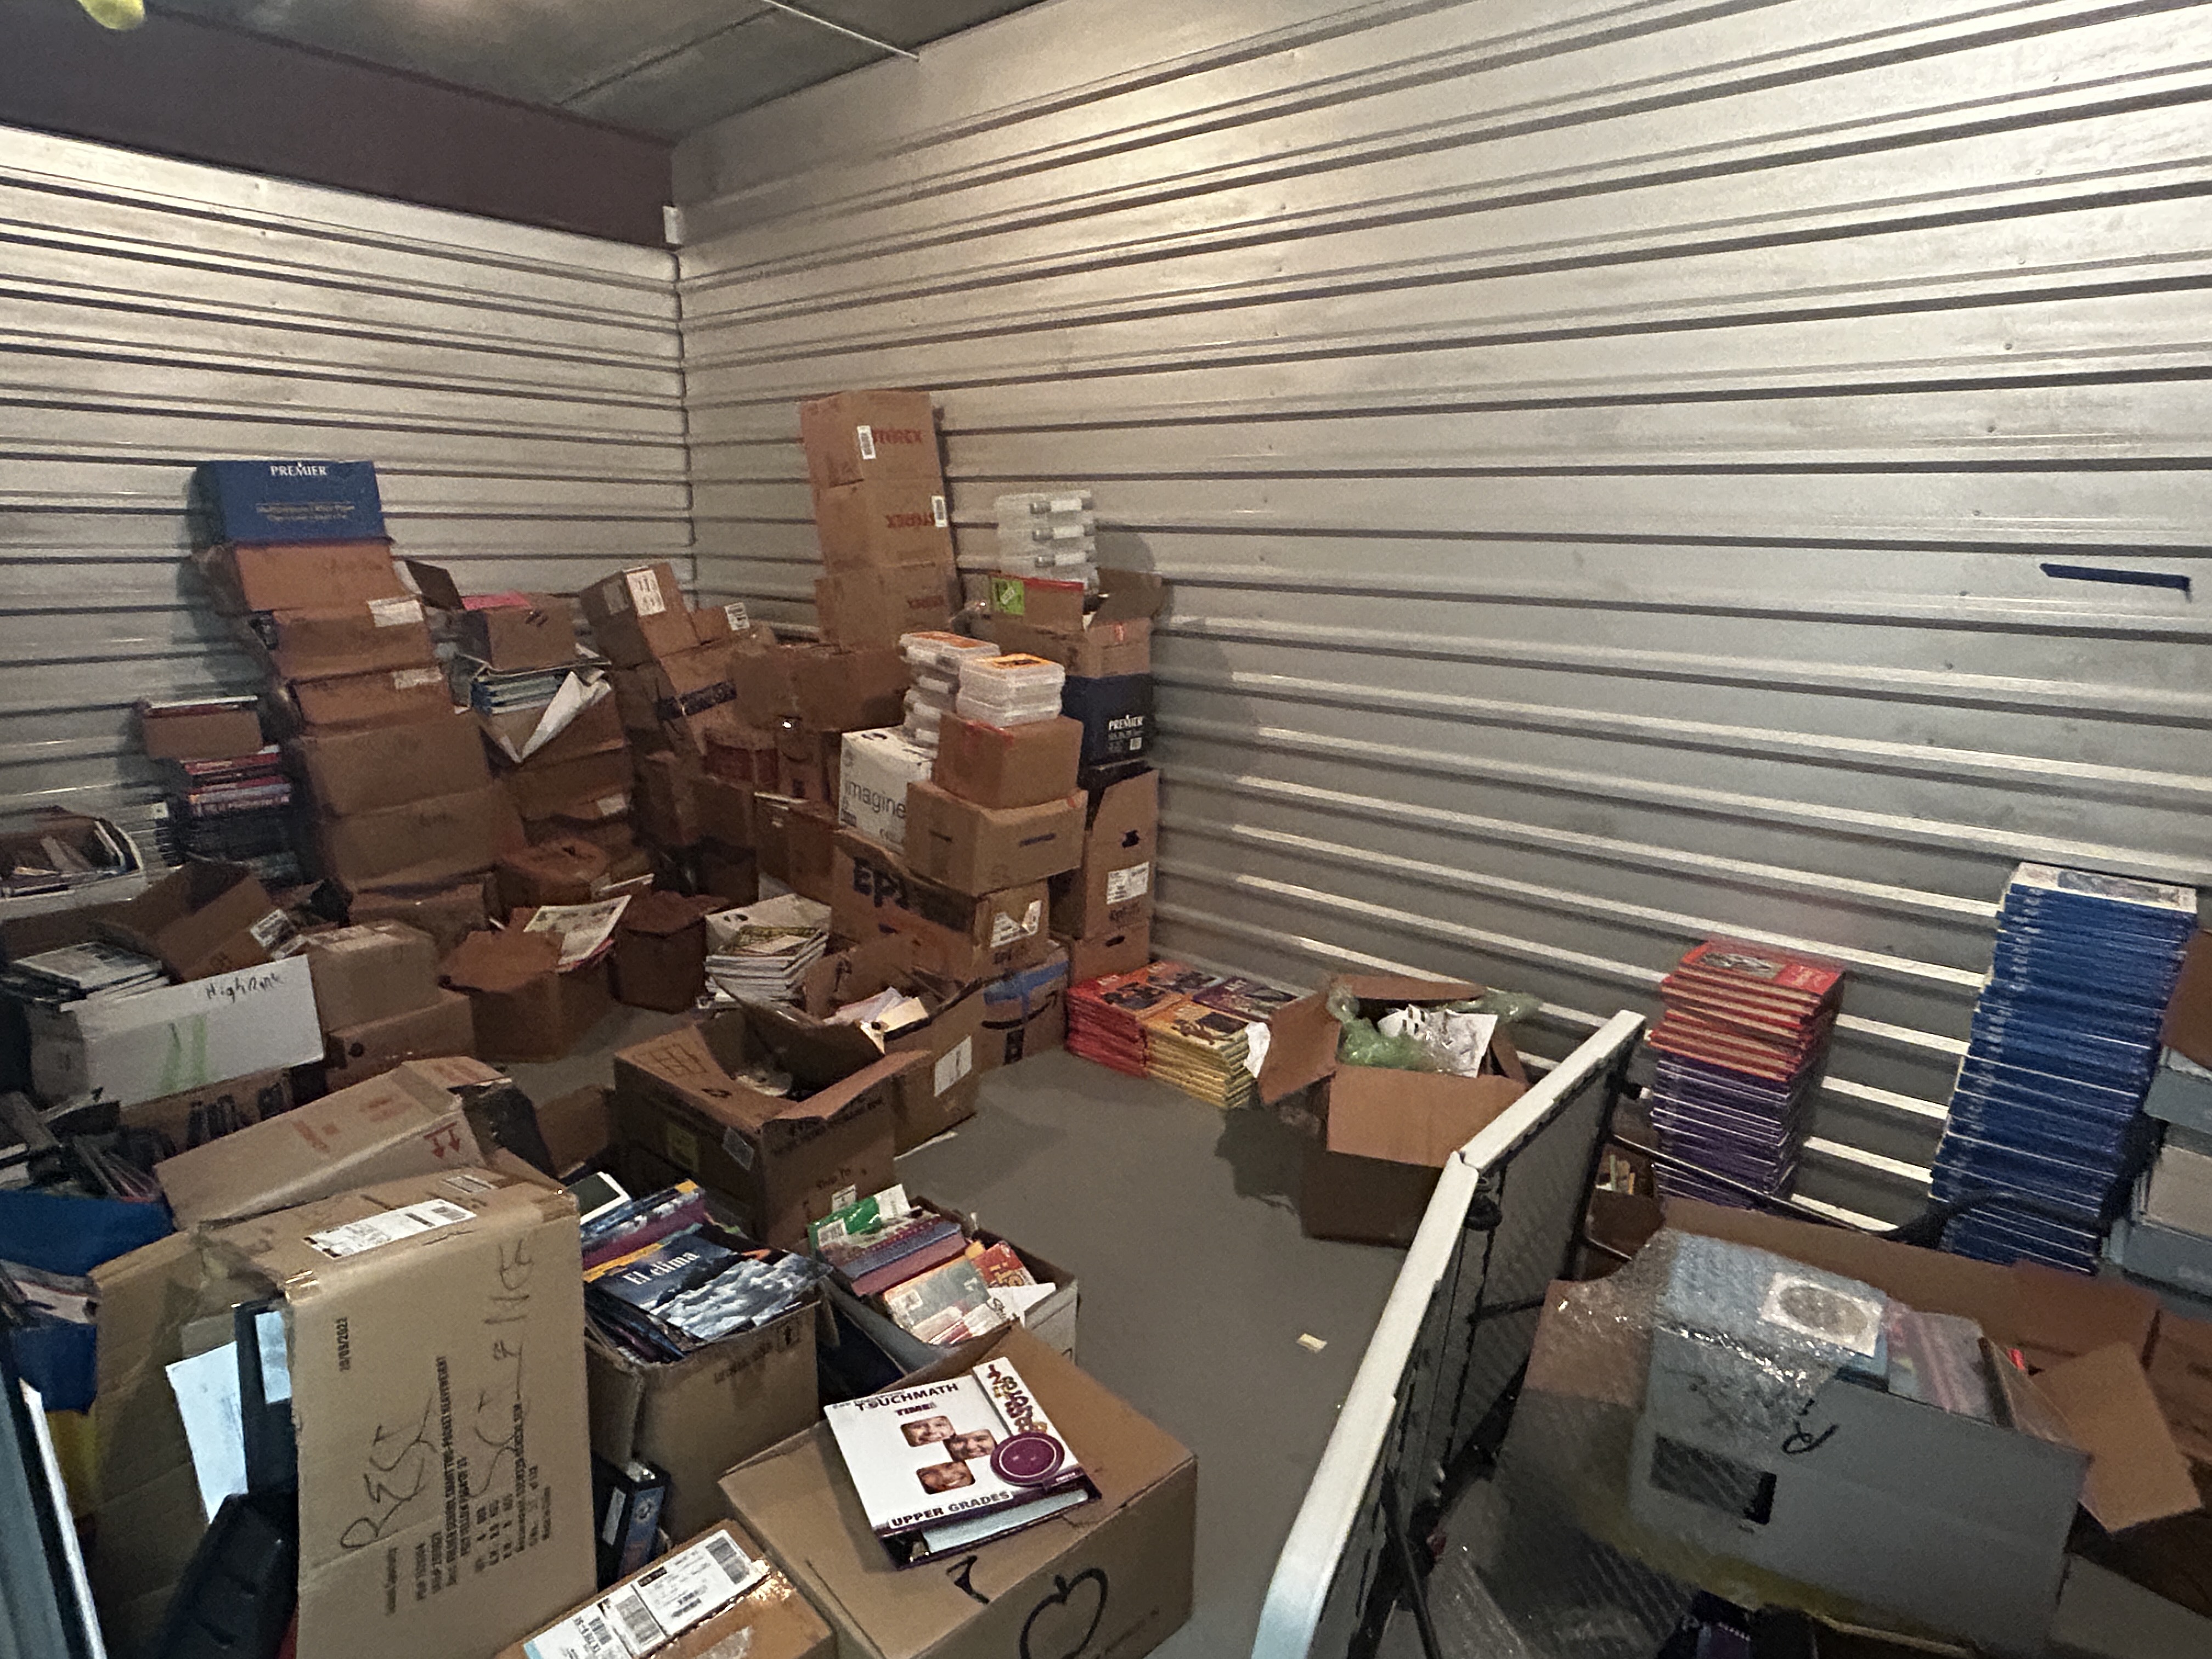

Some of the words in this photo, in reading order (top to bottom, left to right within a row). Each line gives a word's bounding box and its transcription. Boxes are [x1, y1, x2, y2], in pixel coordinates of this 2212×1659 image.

[270, 463, 327, 476] PREMIER
[623, 1271, 652, 1285] El
[650, 1252, 701, 1276] clima
[854, 1383, 959, 1411] TOUCHMATH
[891, 1507, 945, 1526] UPPER
[948, 1490, 1009, 1512] GRADES
